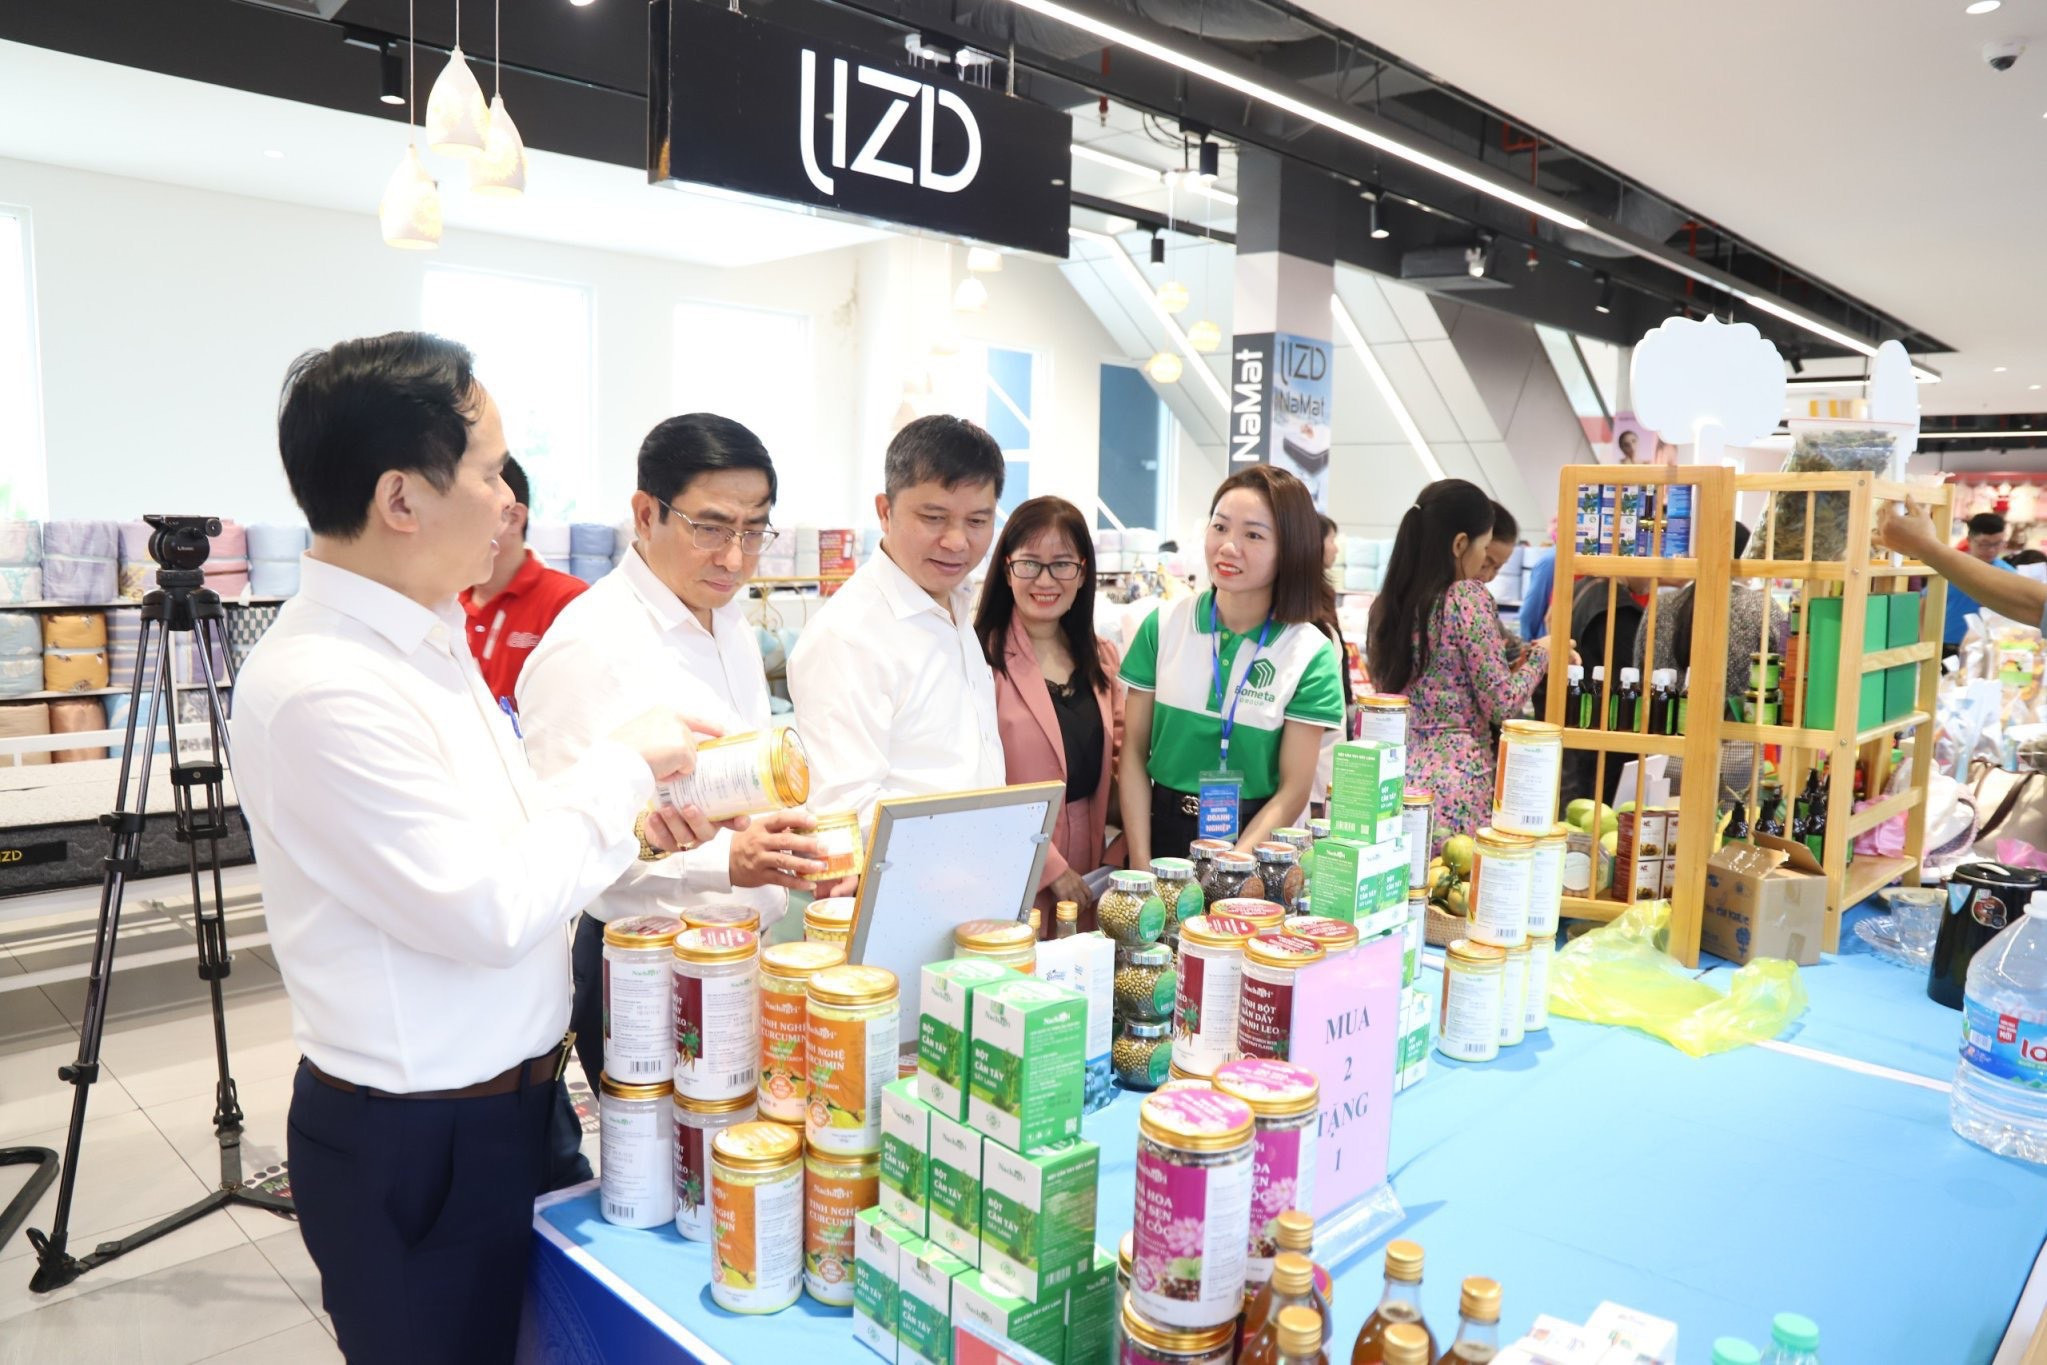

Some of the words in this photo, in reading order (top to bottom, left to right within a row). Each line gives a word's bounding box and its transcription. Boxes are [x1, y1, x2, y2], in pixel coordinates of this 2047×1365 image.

[1232, 348, 1263, 462] NaMat
[0, 850, 22, 862] ZD
[1255, 1012, 1274, 1024] DÂY
[1257, 1004, 1276, 1015] BỘT
[1261, 1024, 1280, 1035] LEO
[1325, 1005, 1370, 1045] MUA
[1343, 1057, 1353, 1081] 2
[1317, 1092, 1369, 1138] TẶNG
[1252, 1163, 1270, 1174] OA
[1334, 1147, 1342, 1171] 1
[1253, 1176, 1270, 1187] EN
[1147, 1188, 1173, 1209] HOA
[1148, 1204, 1172, 1223] SEN
